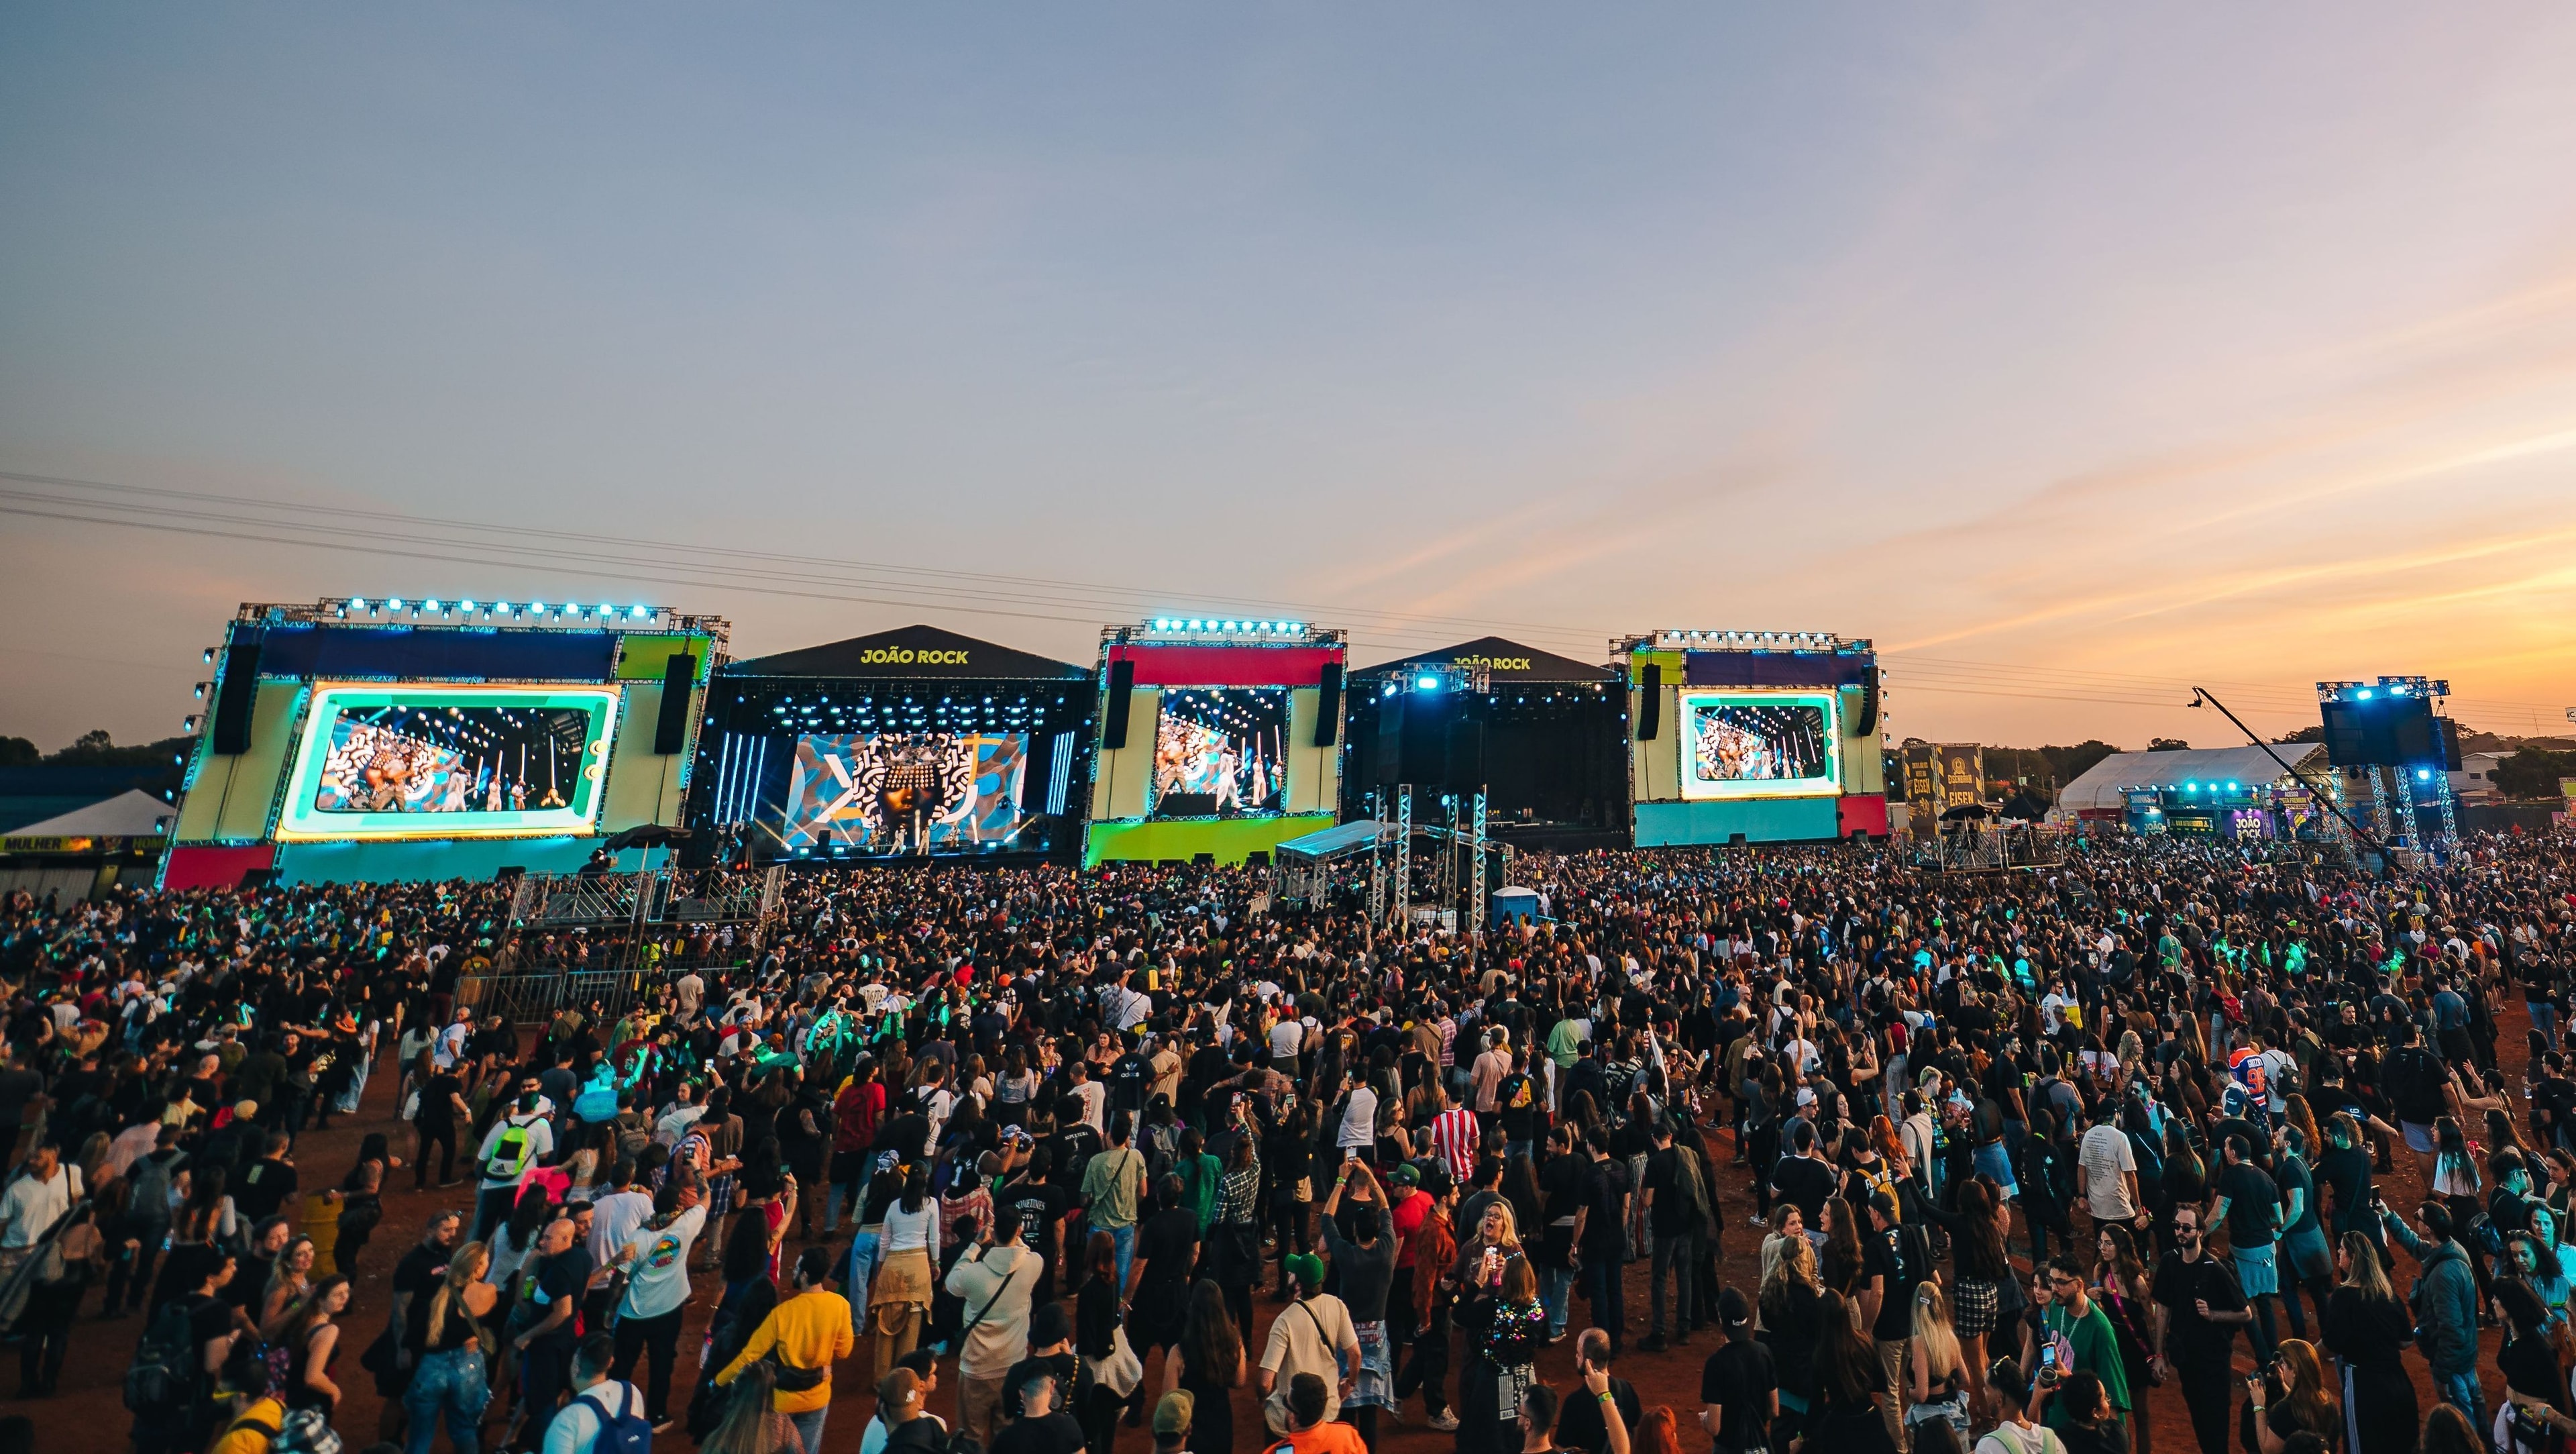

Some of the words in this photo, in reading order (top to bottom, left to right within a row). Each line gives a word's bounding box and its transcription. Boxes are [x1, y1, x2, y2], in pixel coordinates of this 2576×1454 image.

[861, 646, 914, 664] JOÃO
[917, 650, 969, 664] ROCK
[1493, 658, 1531, 670] ROCK
[1914, 778, 1931, 794] EISEN
[1949, 791, 1974, 807] EISEN
[2131, 794, 2151, 803] DRINKS
[2144, 821, 2163, 831] JOÃO
[2235, 815, 2261, 829] JOÃO
[4, 837, 61, 850] MULHER
[1865, 1172, 1881, 1190] FUK
[1015, 1198, 1045, 1210] SOMETIMES
